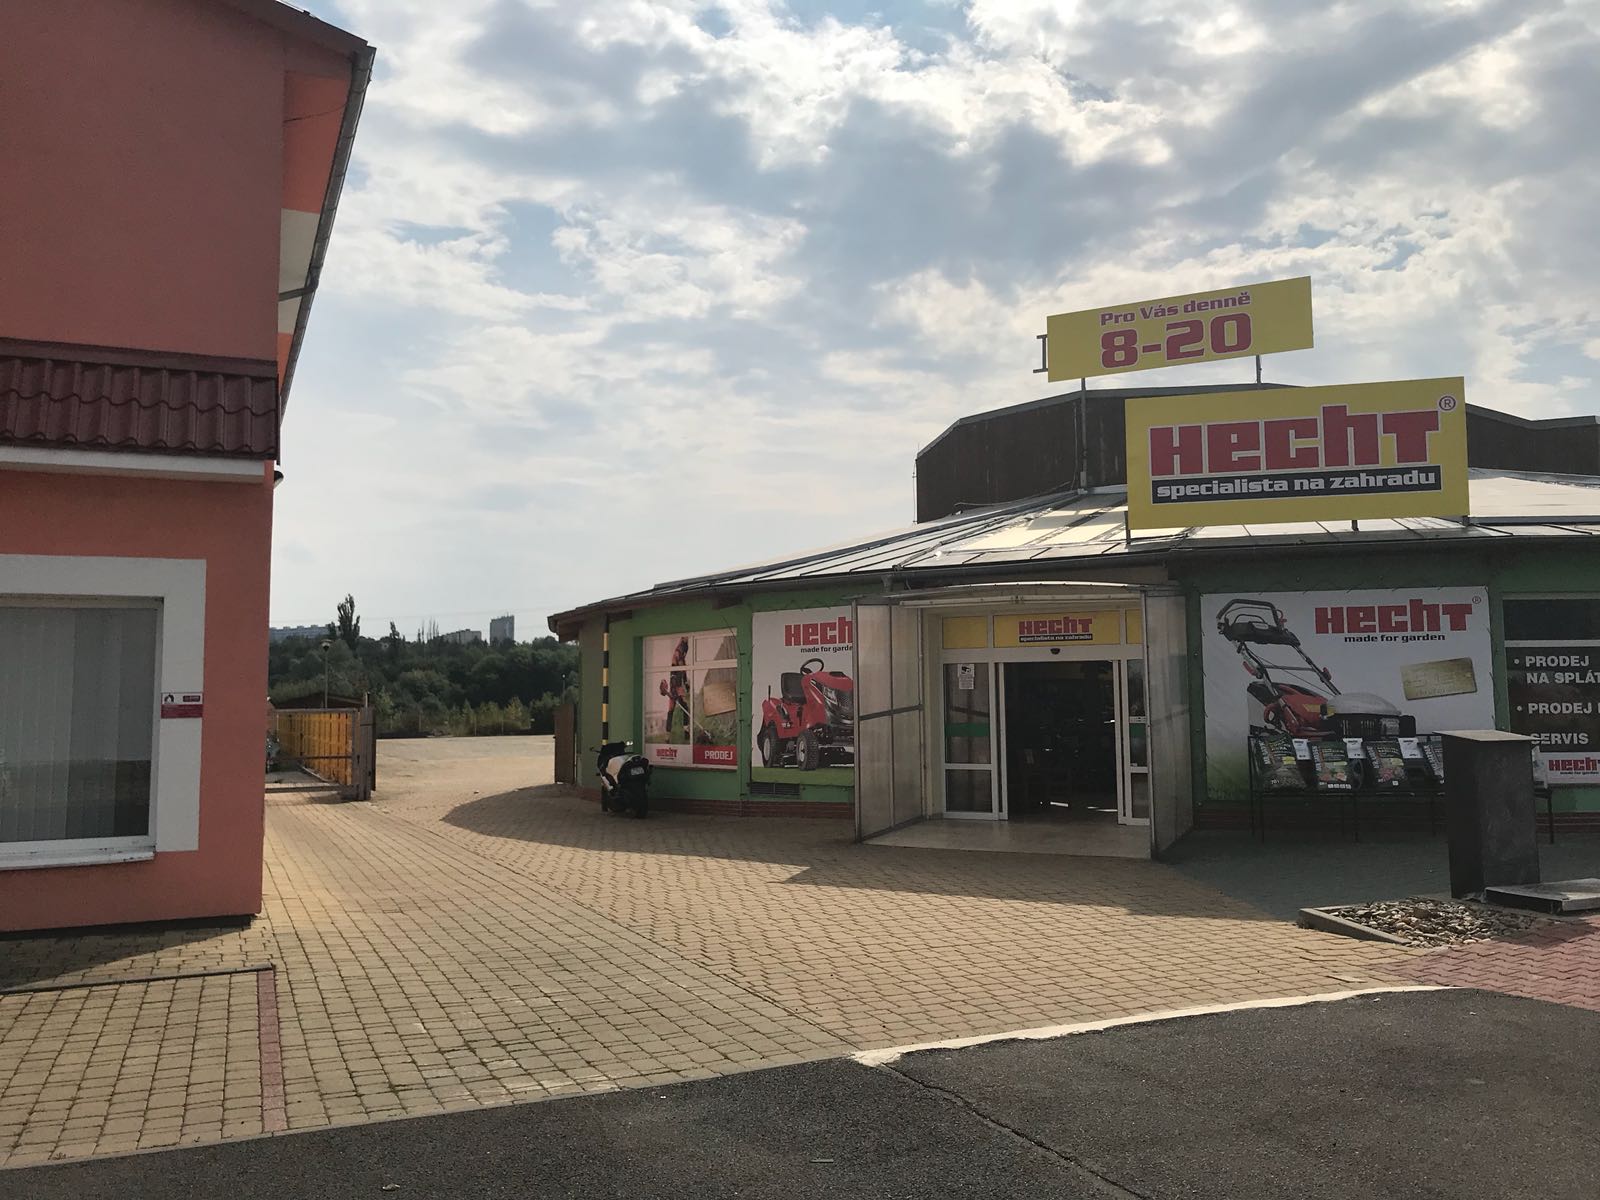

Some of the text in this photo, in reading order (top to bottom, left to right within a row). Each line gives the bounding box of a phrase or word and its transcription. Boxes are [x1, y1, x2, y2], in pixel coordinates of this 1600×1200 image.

[1101, 291, 1251, 326] Pro Vás denně
[1101, 312, 1252, 369] 8-20
[1156, 470, 1436, 500] specialista na zahradu
[784, 616, 853, 646] Hech
[1344, 633, 1446, 643] made for garden
[1525, 655, 1590, 667] PRODEJ
[1526, 672, 1550, 684] NA
[1528, 702, 1593, 714] PRODEJ
[1530, 732, 1589, 745] SERVIS
[704, 750, 733, 761] PRODEJ
[1548, 757, 1600, 771] Hech
